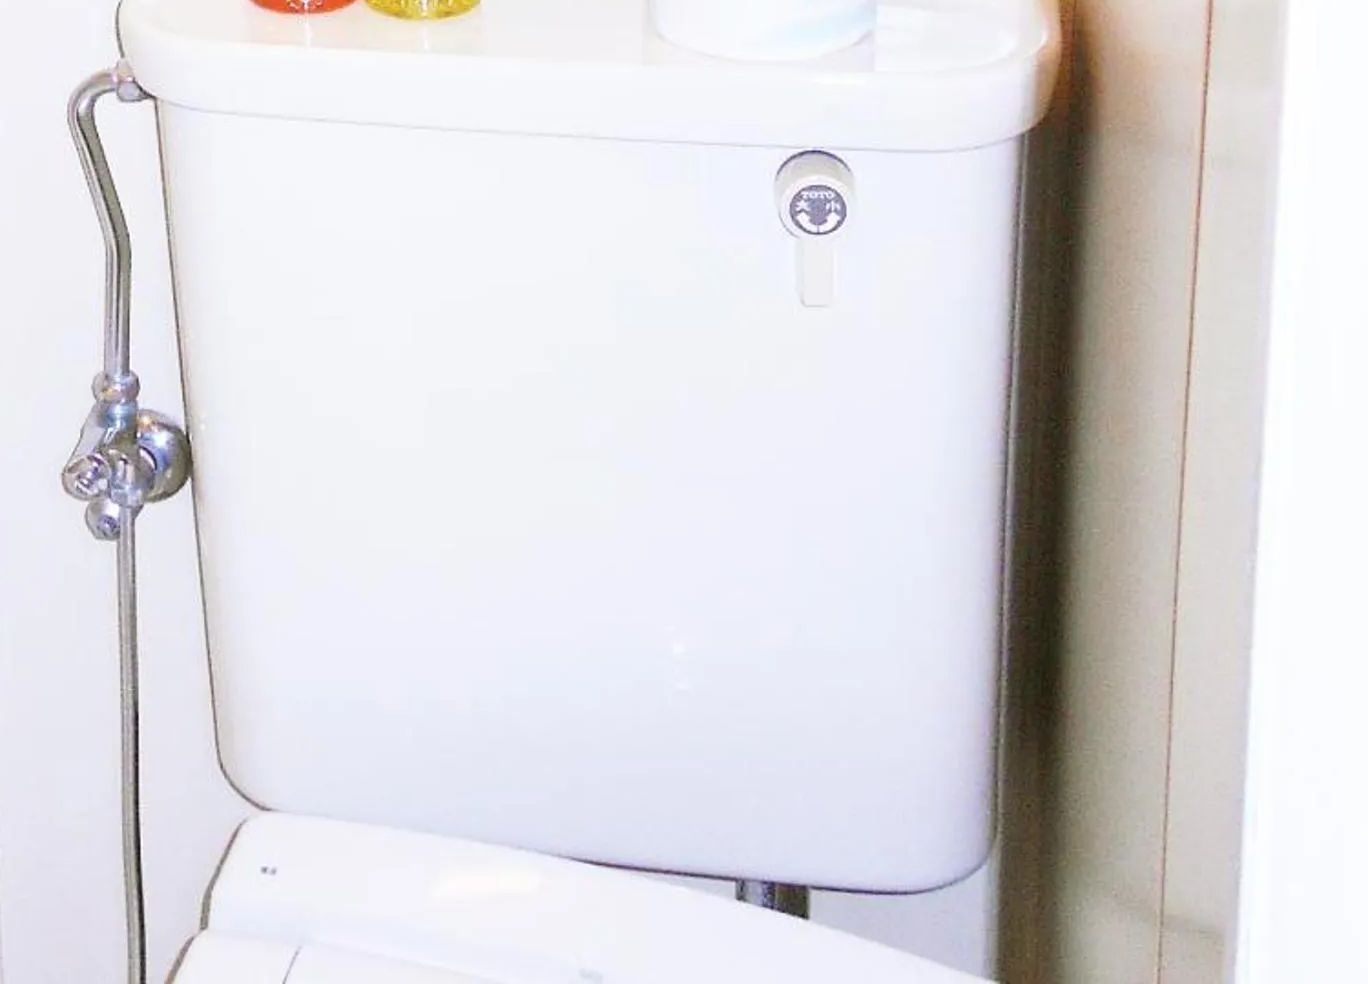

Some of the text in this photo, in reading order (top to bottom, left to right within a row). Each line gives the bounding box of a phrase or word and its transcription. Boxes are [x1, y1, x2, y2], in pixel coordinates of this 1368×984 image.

[800, 190, 835, 200] TOTO
[795, 200, 812, 213] 大
[825, 200, 841, 213] 小
